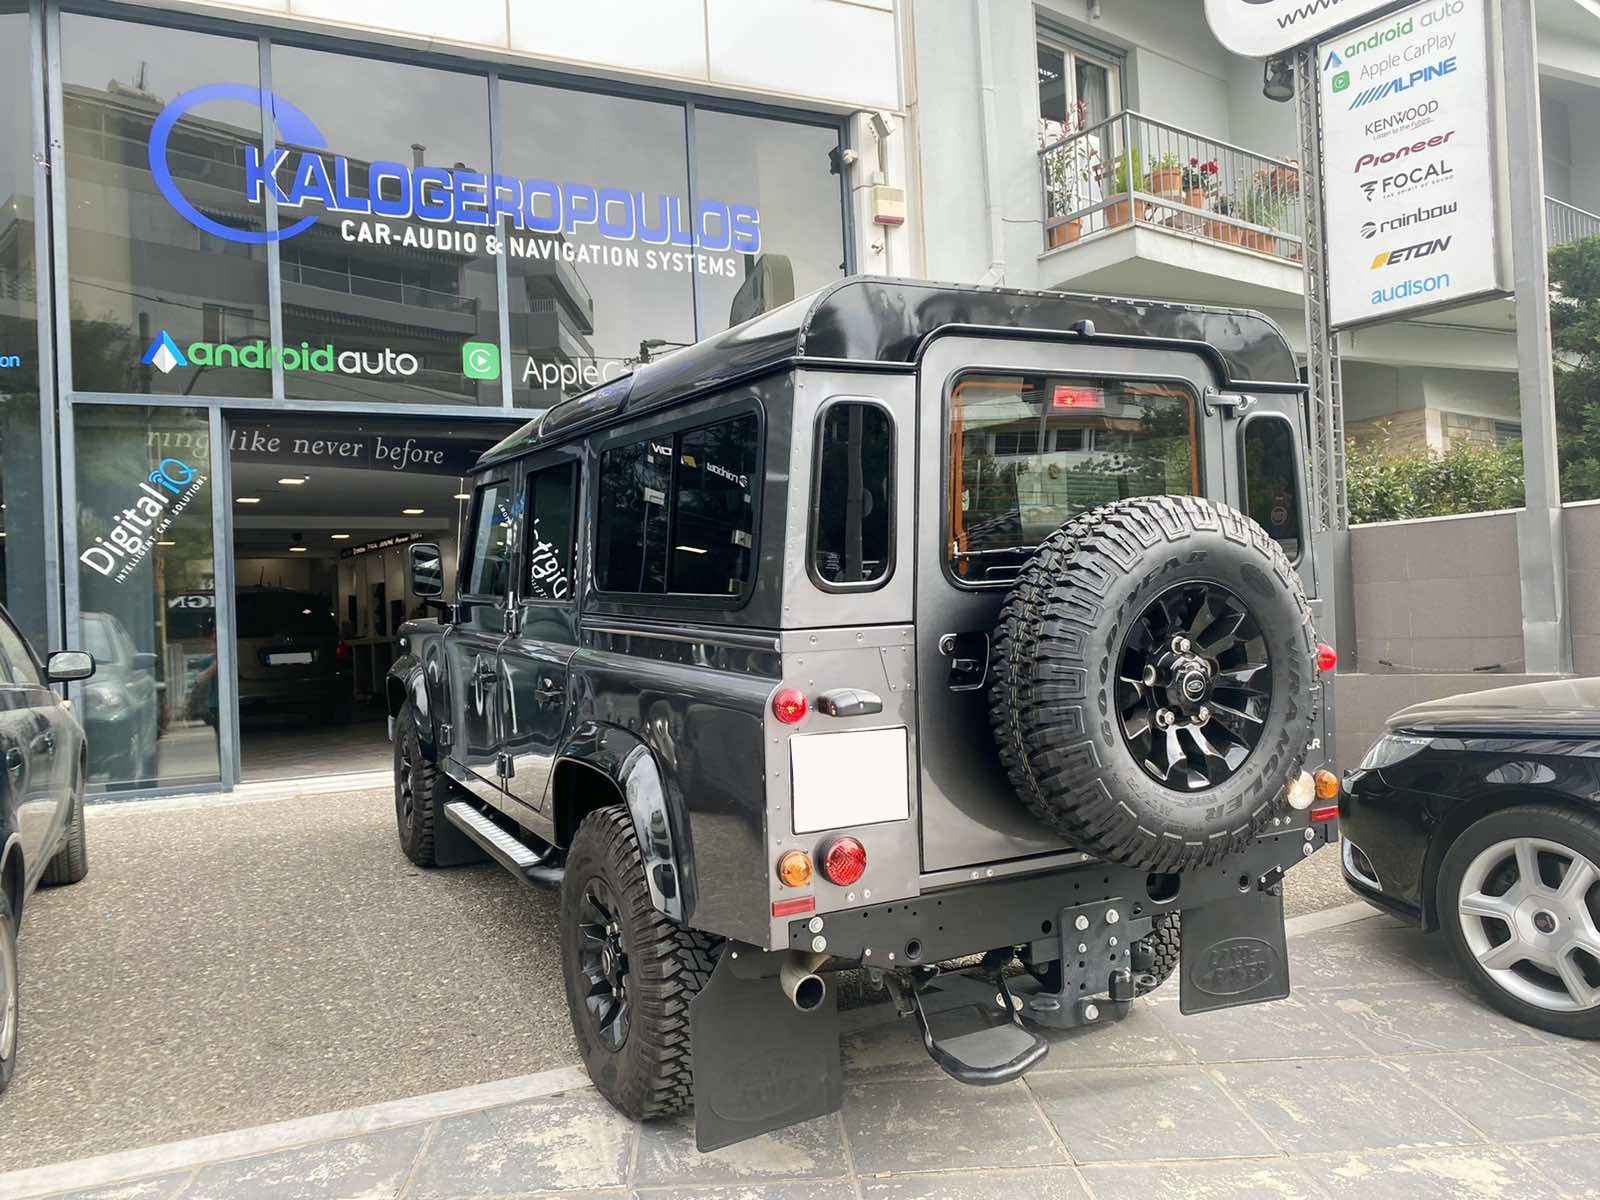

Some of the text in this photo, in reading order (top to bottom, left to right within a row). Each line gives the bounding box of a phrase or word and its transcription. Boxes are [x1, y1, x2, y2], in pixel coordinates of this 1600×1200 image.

[1344, 0, 1465, 59] android auto
[1359, 31, 1457, 82] Apple CarPlay
[1366, 56, 1457, 104] ALPINE
[1364, 99, 1439, 137] KENWOOD
[1353, 130, 1456, 174] Pioneer
[1382, 159, 1454, 193] FOCAL
[244, 144, 762, 256] KALOGEROPOULOS
[1380, 201, 1458, 234] rainbow
[341, 219, 737, 277] CAR-AUDIO & NAVIGATION SYSTEMS
[1386, 236, 1453, 266] ETON
[1371, 273, 1450, 305] audison
[187, 340, 419, 376] android auto
[522, 356, 599, 391] Apple
[229, 429, 281, 453] like
[293, 435, 364, 458] never
[374, 436, 445, 470] before
[114, 475, 209, 584] INTELLIGENT CAR SOLUTIONS
